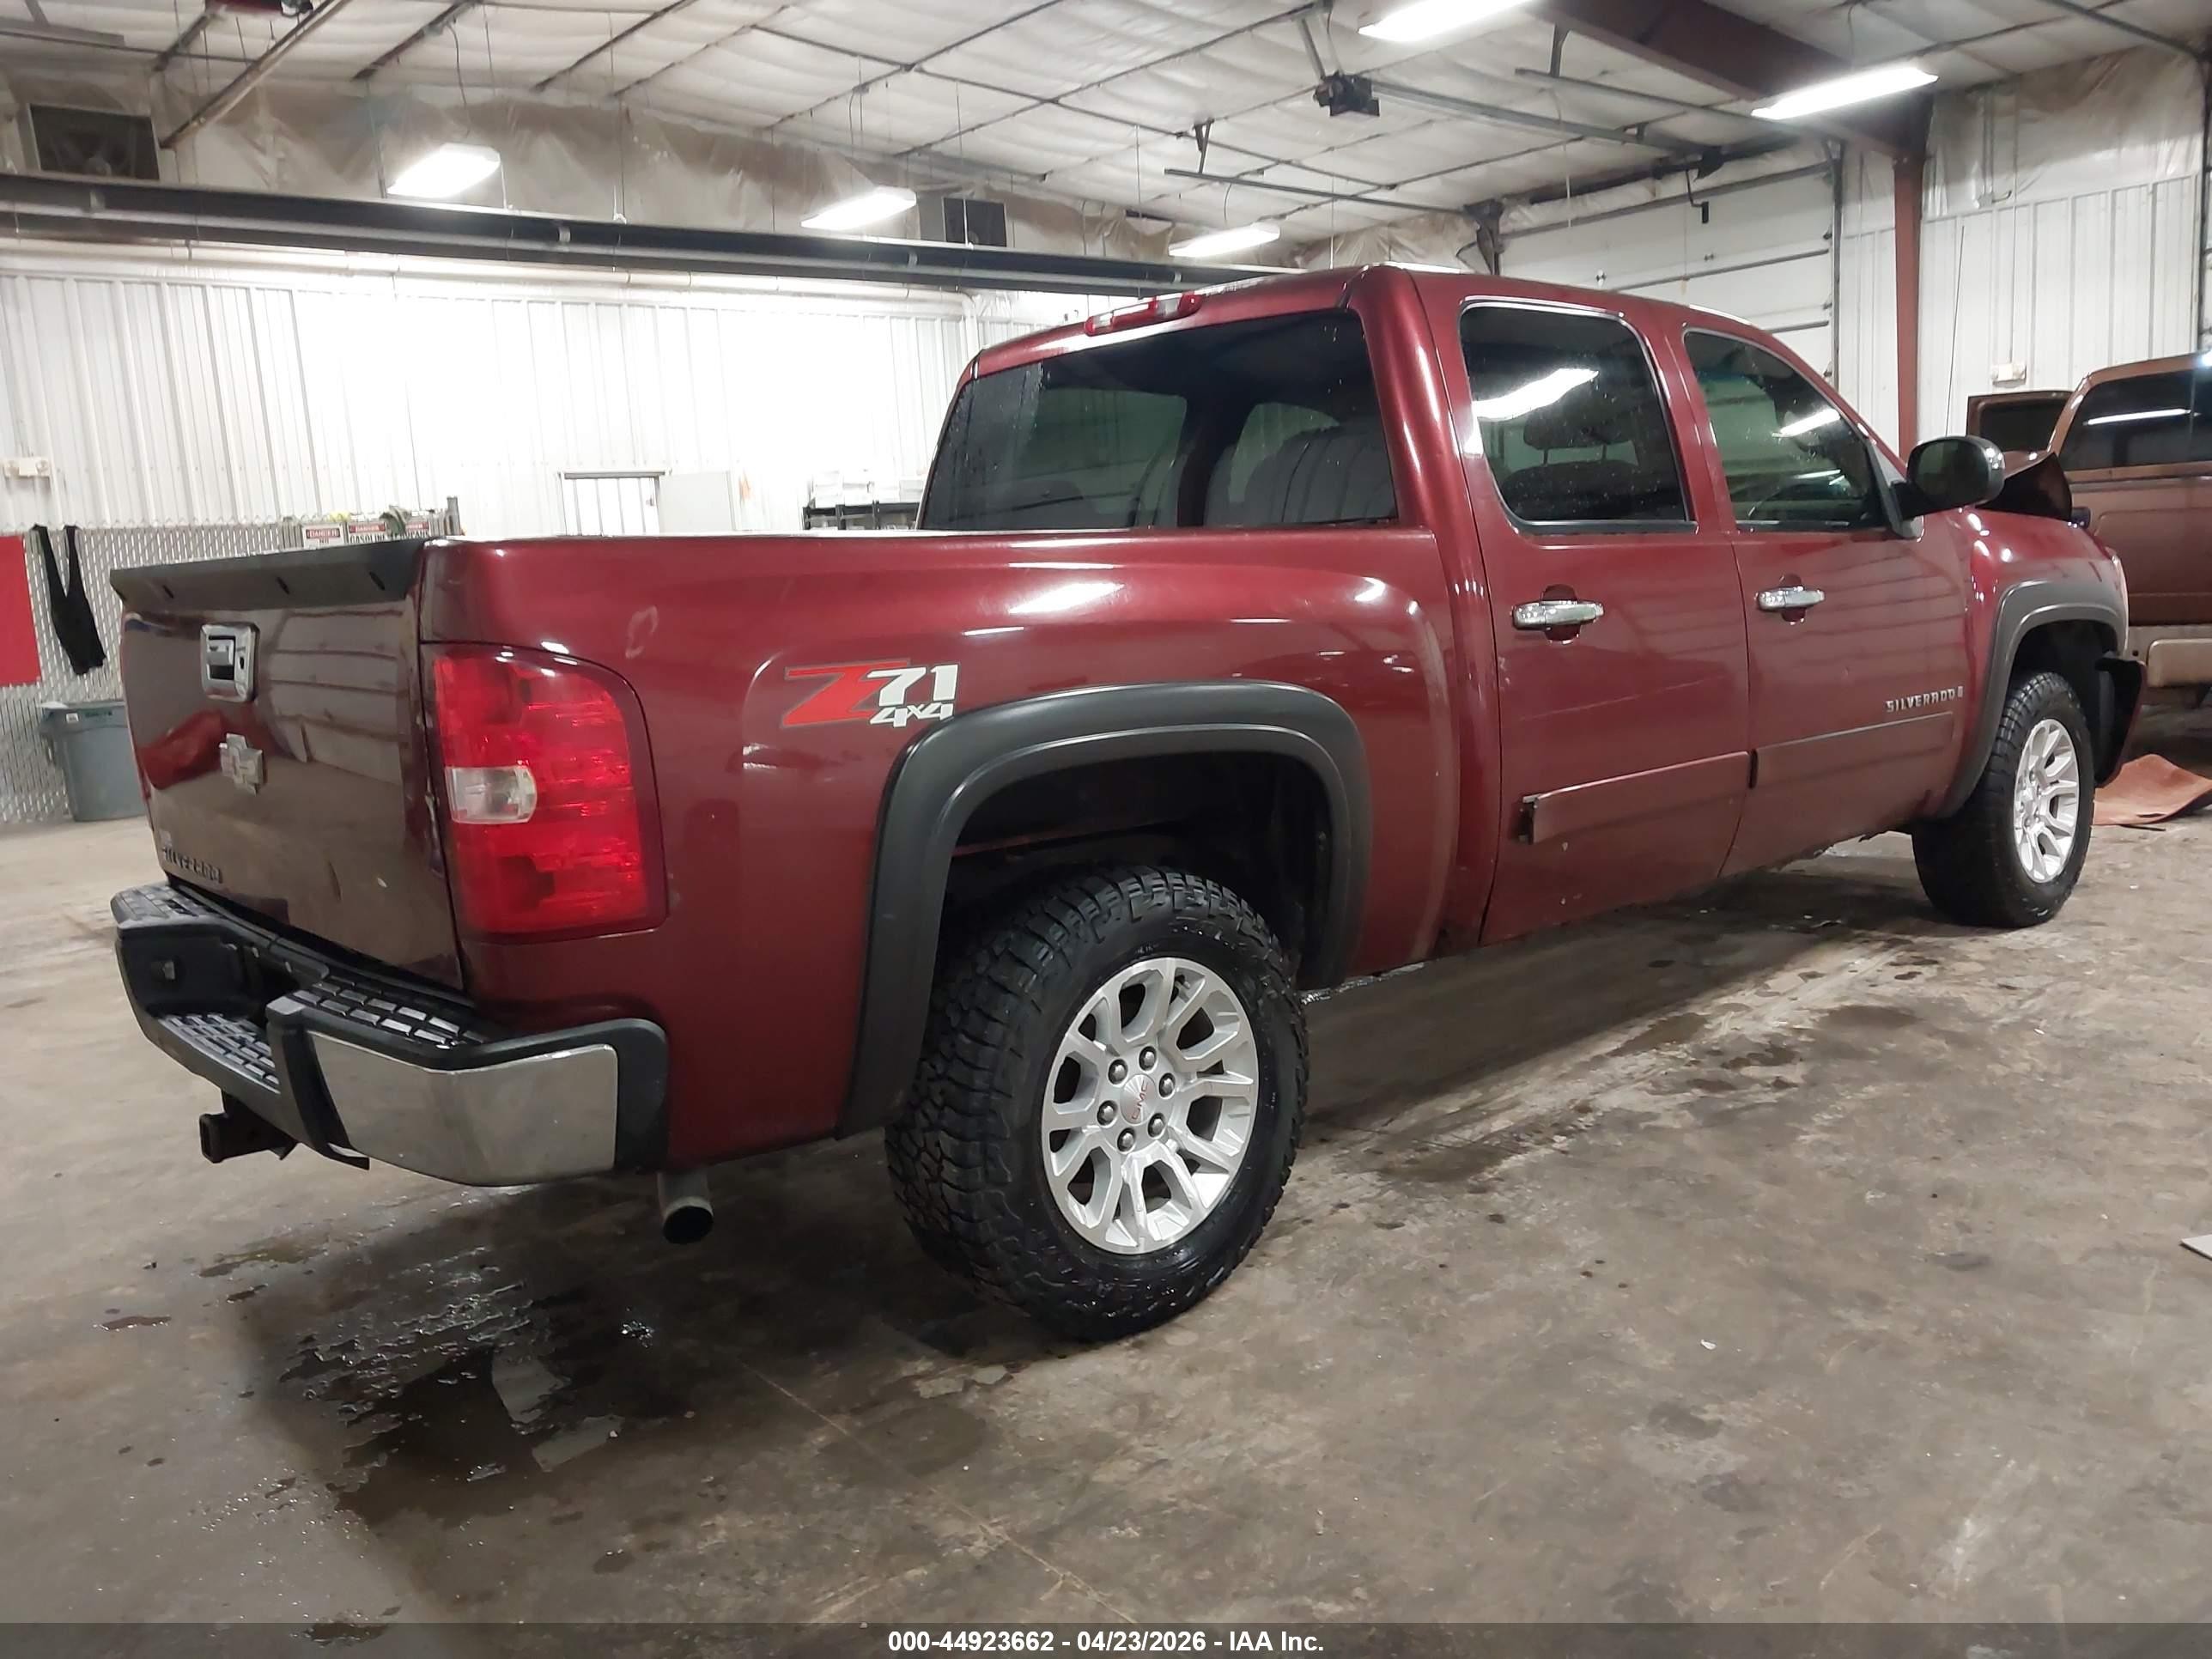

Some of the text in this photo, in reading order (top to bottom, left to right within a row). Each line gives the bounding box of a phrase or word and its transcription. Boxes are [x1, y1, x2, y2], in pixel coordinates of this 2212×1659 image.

[782, 659, 958, 727] Z71
[1885, 688, 1956, 713] SILVERADO
[869, 701, 954, 728] 4x4
[1131, 1079, 1149, 1121] GMC
